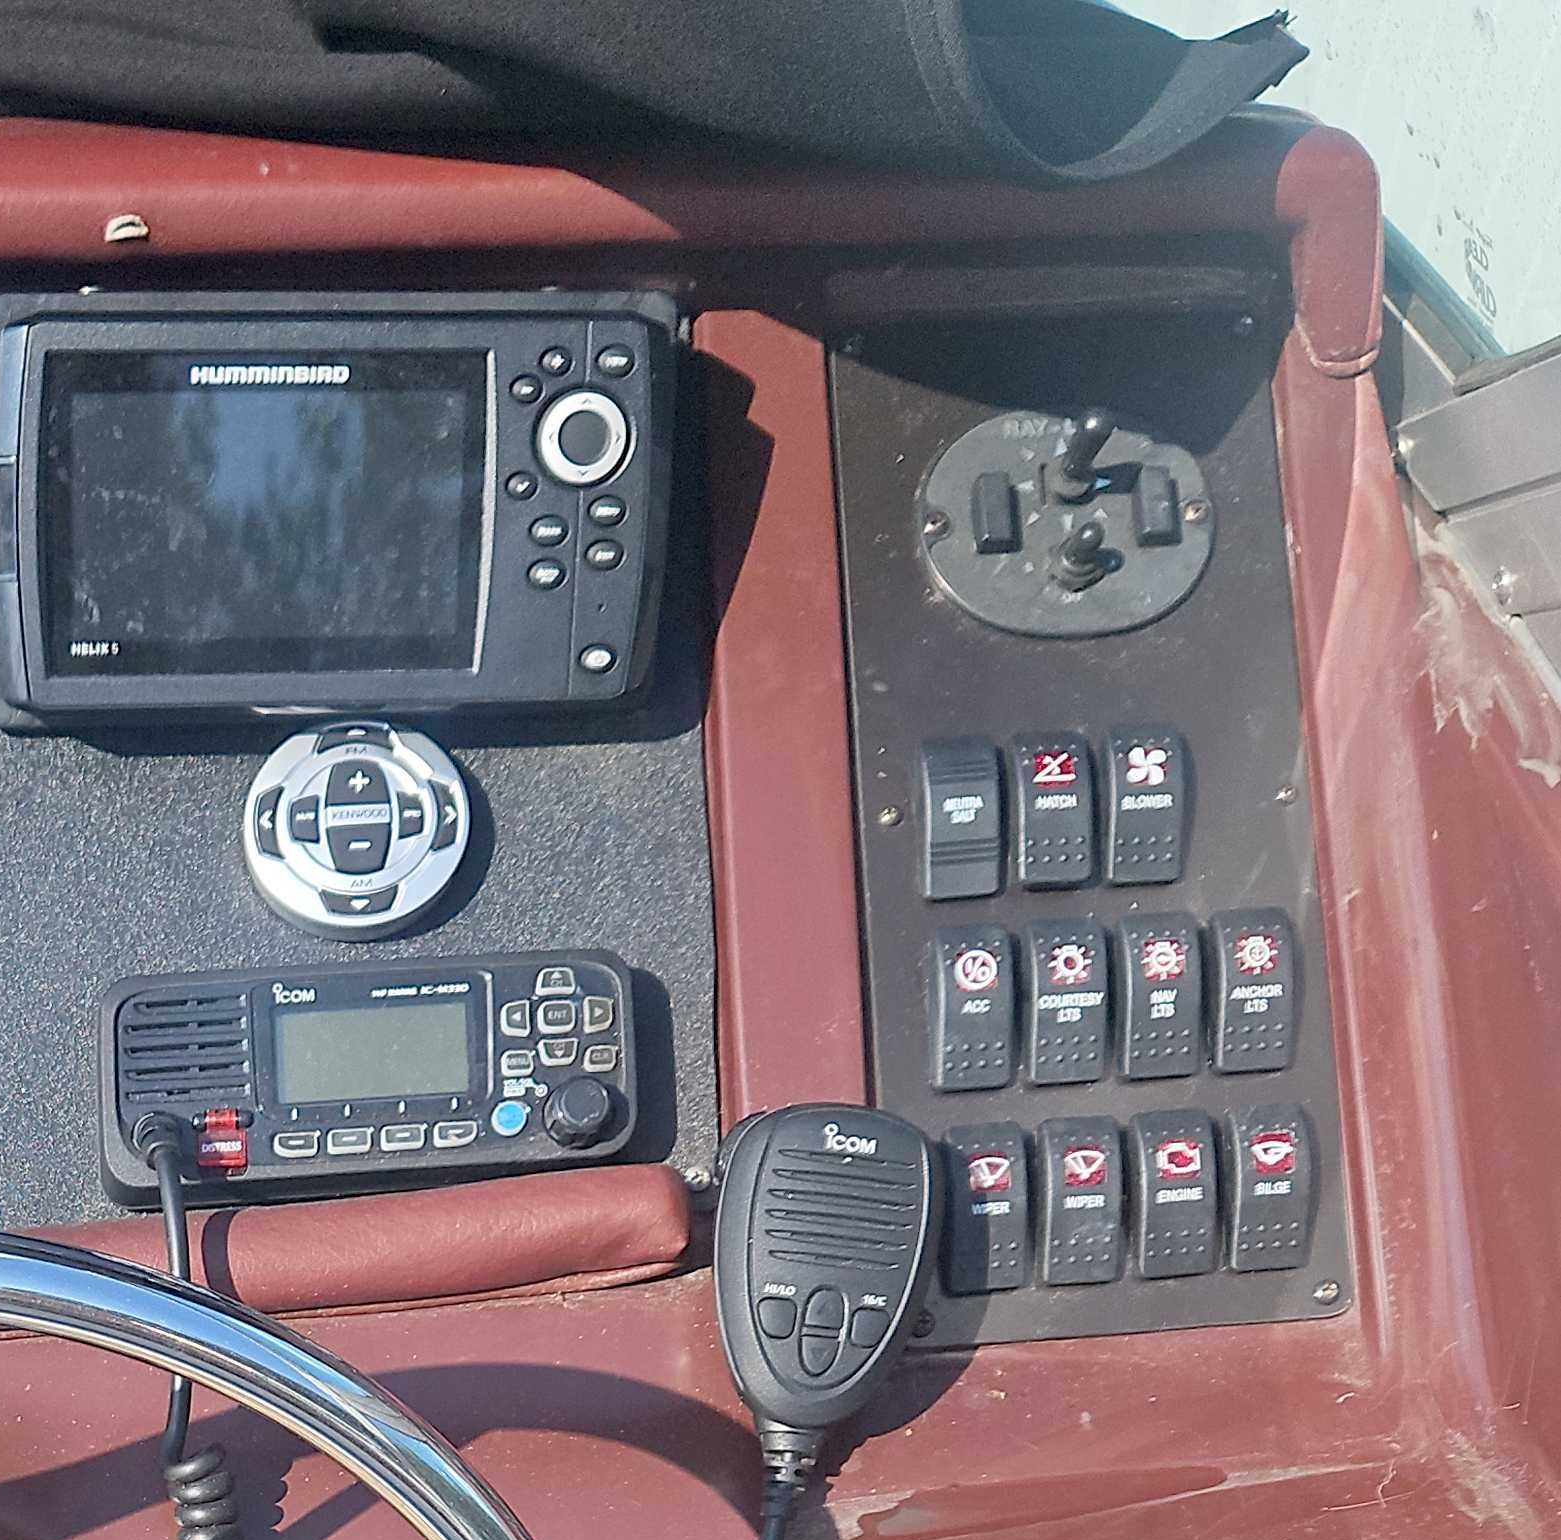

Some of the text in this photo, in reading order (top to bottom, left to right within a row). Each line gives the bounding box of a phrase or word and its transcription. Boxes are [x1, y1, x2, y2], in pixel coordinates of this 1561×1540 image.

[190, 365, 350, 385] HUMMINBIRD
[1034, 793, 1078, 811] HATCH
[1121, 794, 1174, 811] BLOWER
[330, 807, 388, 822] KENWOOD
[1149, 989, 1178, 1005] NAV
[1229, 983, 1284, 1000] ANCHOR
[1039, 992, 1105, 1010] COURTESY
[1243, 998, 1269, 1015] LTS
[548, 1010, 567, 1020] ENT
[1057, 1007, 1082, 1023] LTS
[1150, 1003, 1175, 1020] LTS
[201, 1141, 242, 1153] DISTRESS
[1155, 1186, 1204, 1204] ENGINE
[1254, 1179, 1292, 1197] BILGE
[971, 1200, 1011, 1216] WIPER
[1064, 1194, 1105, 1210] WIPER
